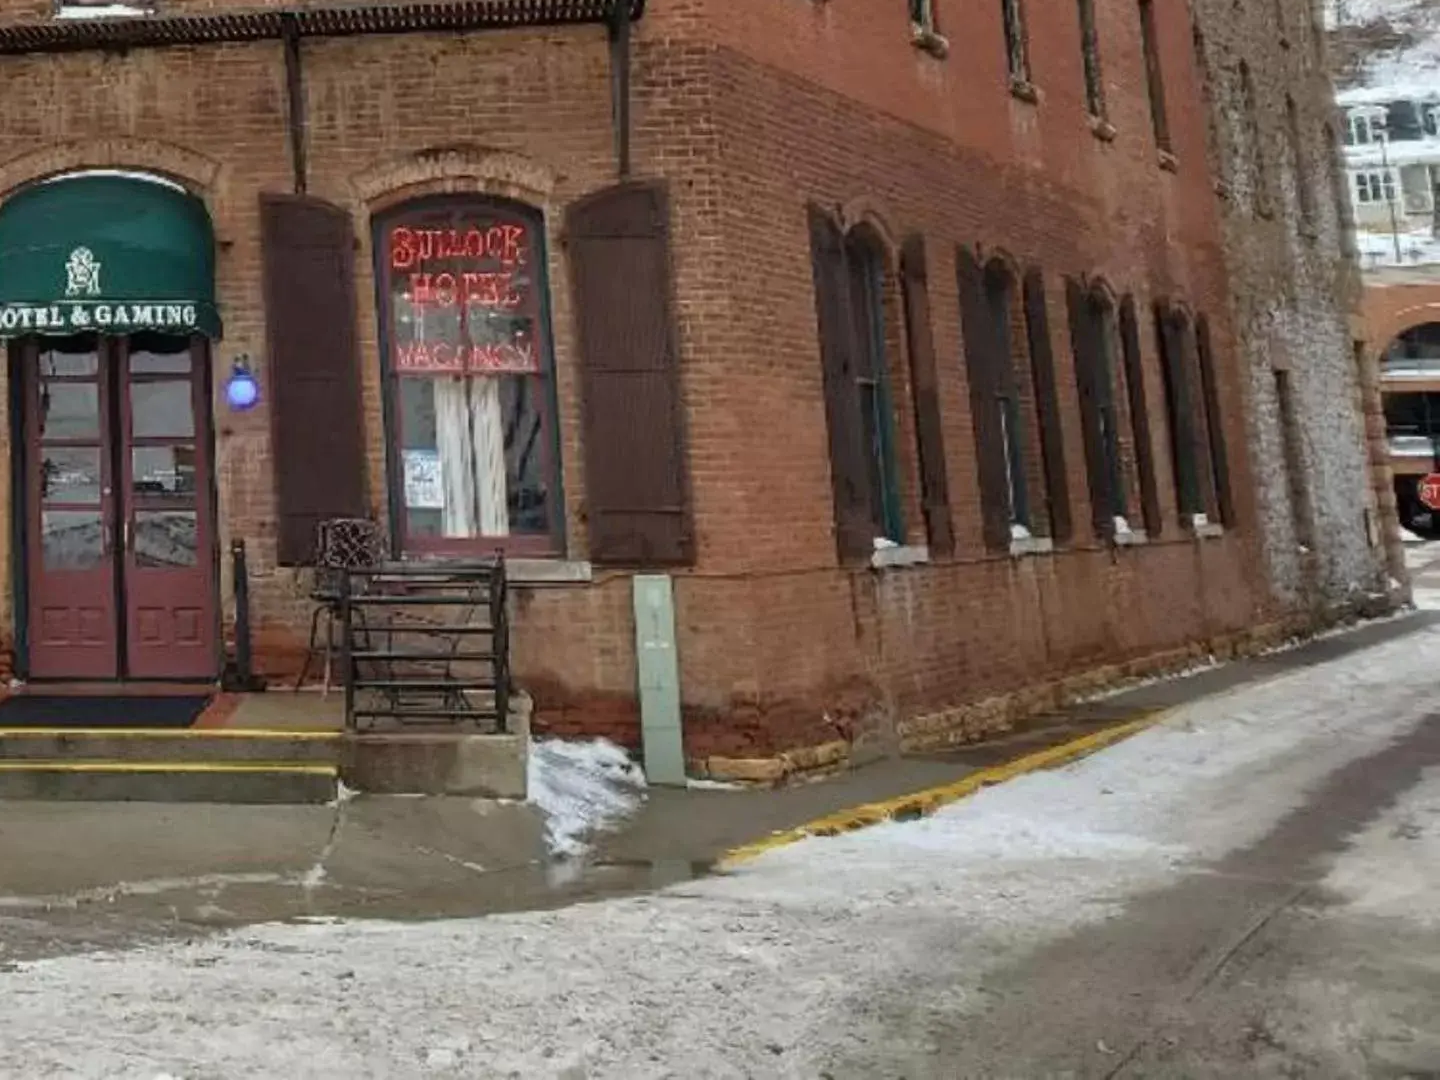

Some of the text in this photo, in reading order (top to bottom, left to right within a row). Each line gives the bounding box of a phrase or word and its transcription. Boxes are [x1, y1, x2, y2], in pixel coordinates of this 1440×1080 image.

[391, 224, 525, 268] BULLOCK
[410, 273, 522, 307] HOTEL
[70, 305, 92, 327] &
[94, 304, 198, 326] GAMING
